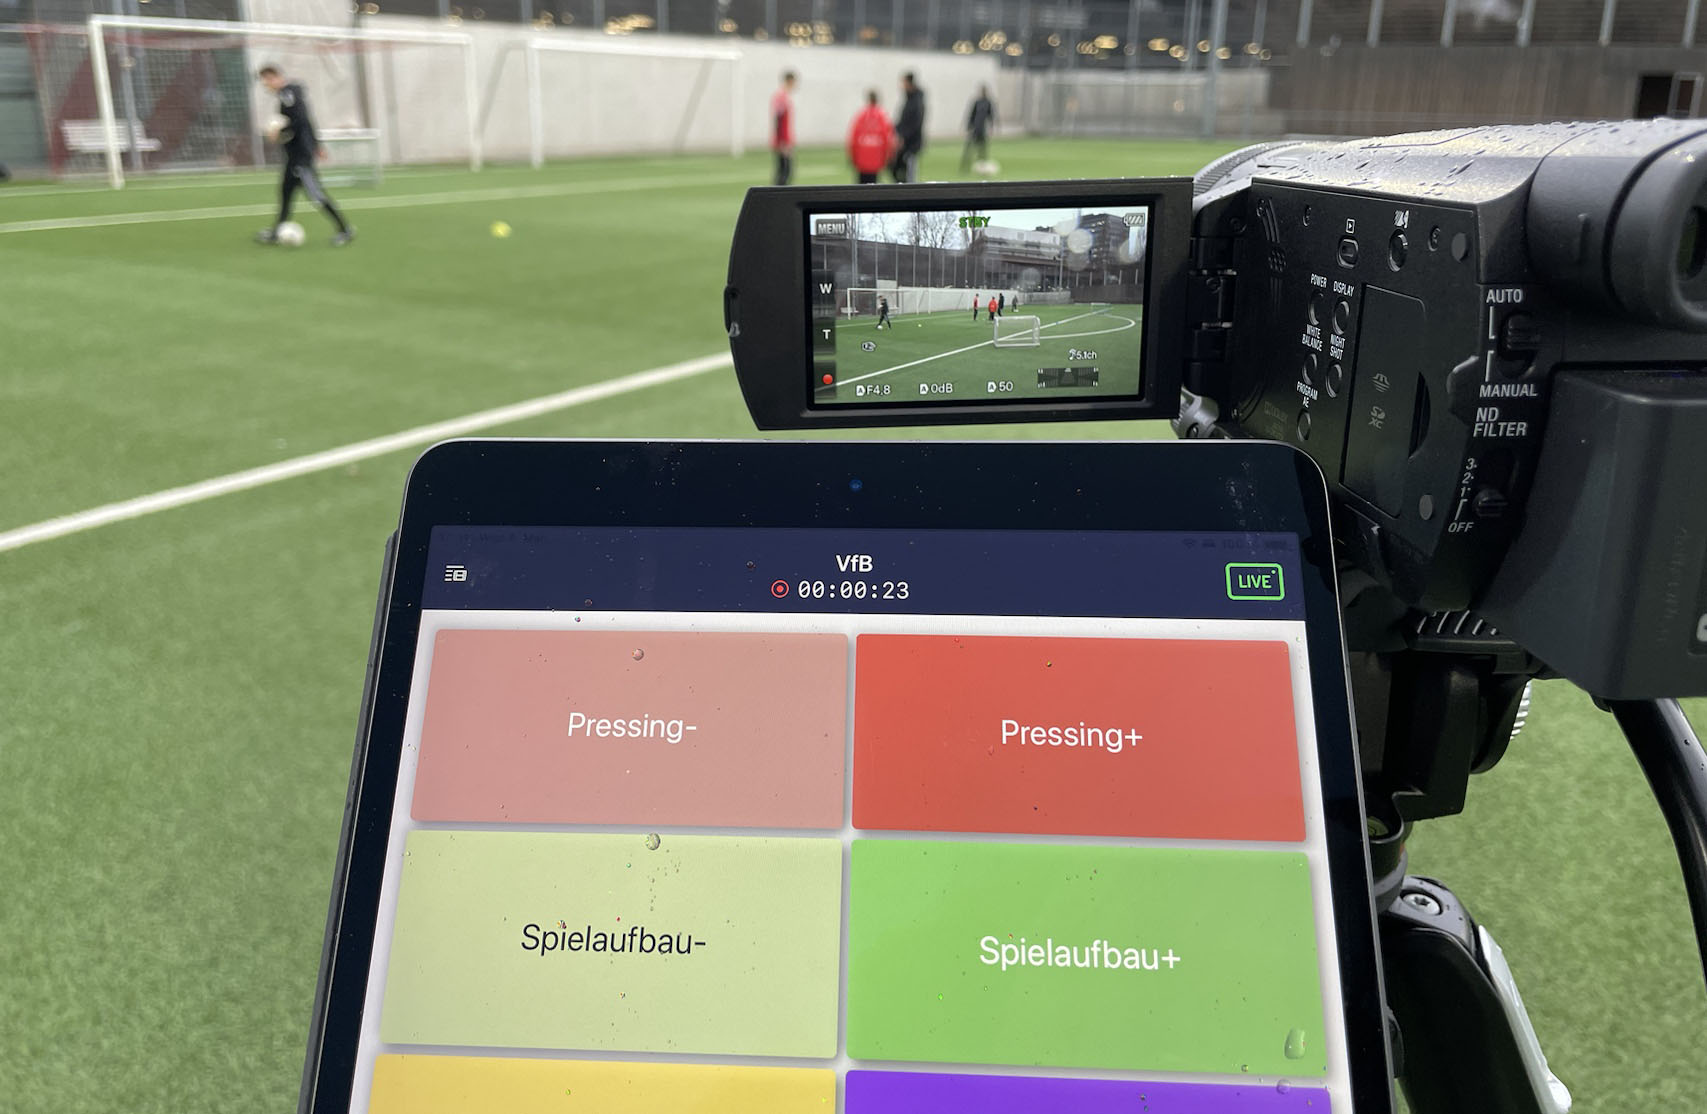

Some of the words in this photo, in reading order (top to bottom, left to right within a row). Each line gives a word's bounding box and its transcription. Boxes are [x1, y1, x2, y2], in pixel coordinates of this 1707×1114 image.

[817, 222, 845, 235] MENU
[958, 216, 991, 228] STBY
[819, 283, 833, 294] W
[1310, 273, 1328, 288] POWER
[1333, 280, 1355, 297] DISPLAY
[1486, 288, 1523, 304] AUTO
[822, 329, 831, 340] T
[1306, 323, 1321, 339] WHITE
[1301, 333, 1323, 352] BALANCE
[1330, 333, 1346, 349] NIGHT
[1329, 345, 1343, 360] SHOT
[931, 382, 953, 394] 0dB
[999, 381, 1014, 392] 50
[1296, 381, 1318, 400] PROGRAM
[1479, 384, 1538, 398] MANUAL
[1476, 406, 1499, 422] ND
[1473, 422, 1528, 437] FILTER
[1448, 522, 1474, 533] OFF
[836, 554, 873, 573] VfB
[798, 580, 909, 599] 00:00:23
[1238, 574, 1272, 589] LIVE
[567, 711, 697, 744] Pressing-
[1001, 719, 1144, 753] Pressing+
[520, 922, 707, 957] Spielaufbau-
[979, 935, 1181, 971] Spielaufbau+
